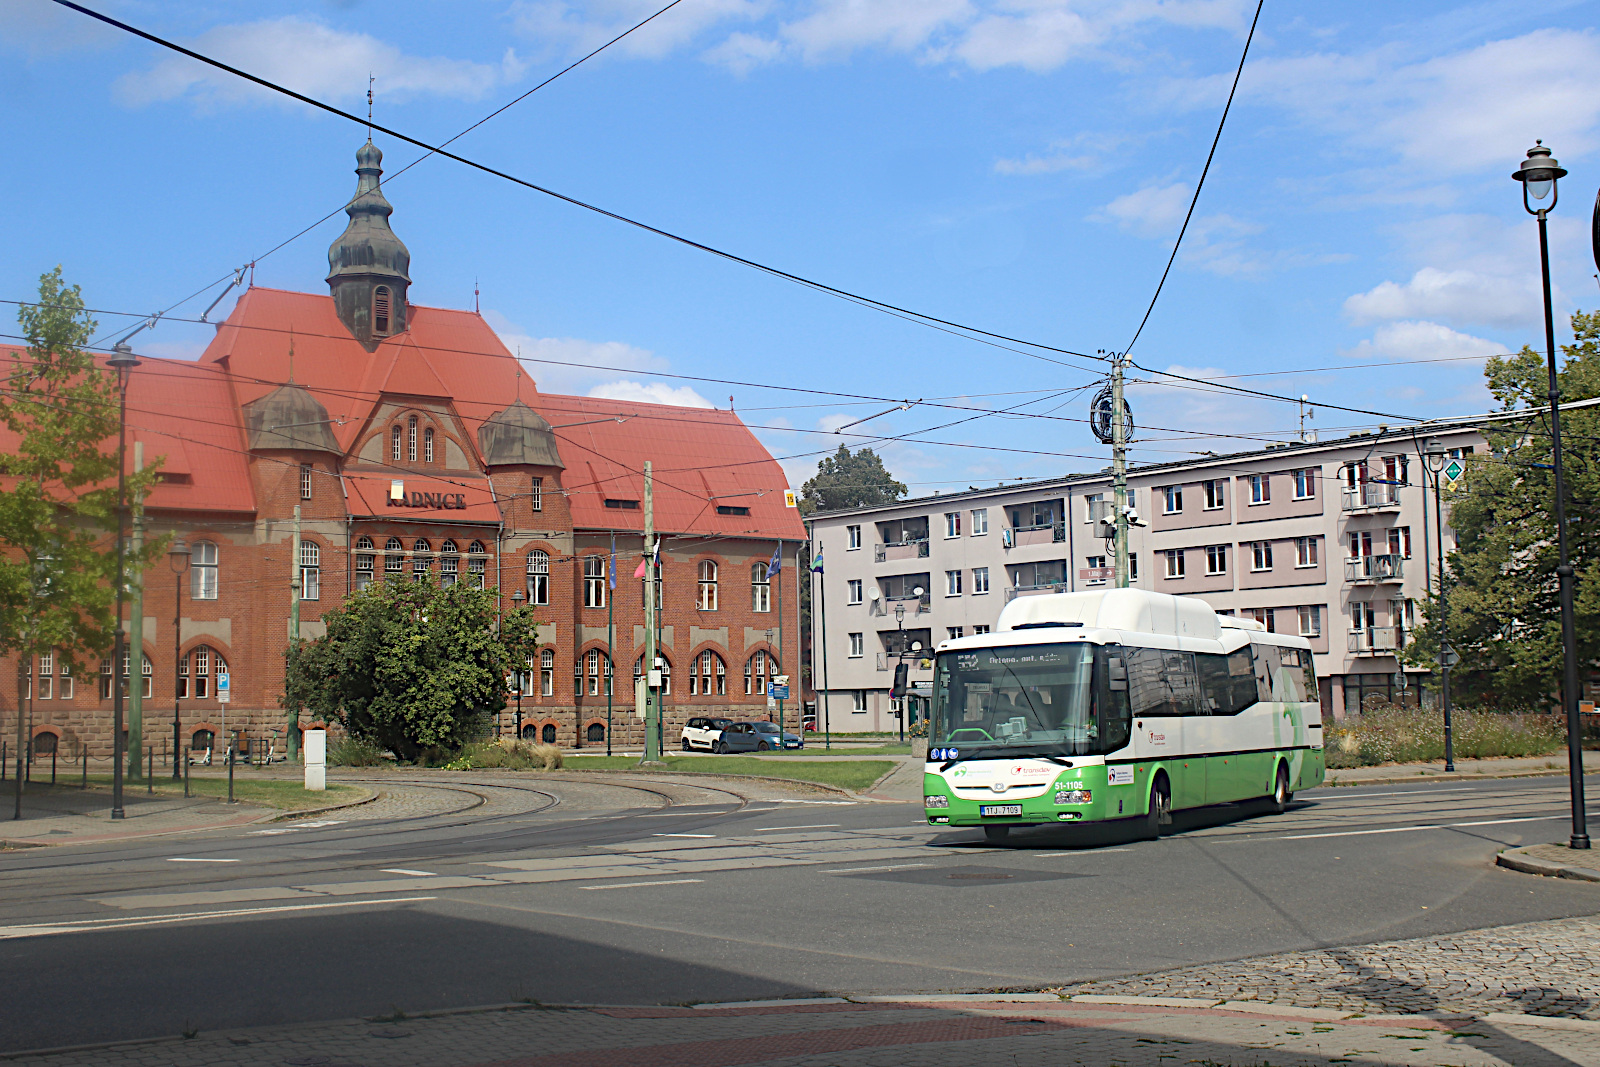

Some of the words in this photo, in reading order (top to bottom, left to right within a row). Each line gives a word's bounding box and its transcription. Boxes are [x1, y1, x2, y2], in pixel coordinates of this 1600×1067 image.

[220, 675, 227, 685] P
[768, 683, 774, 692] P
[1054, 781, 1083, 790] 51-1105
[986, 807, 998, 815] 1TJ
[1002, 806, 1019, 814] 7109
